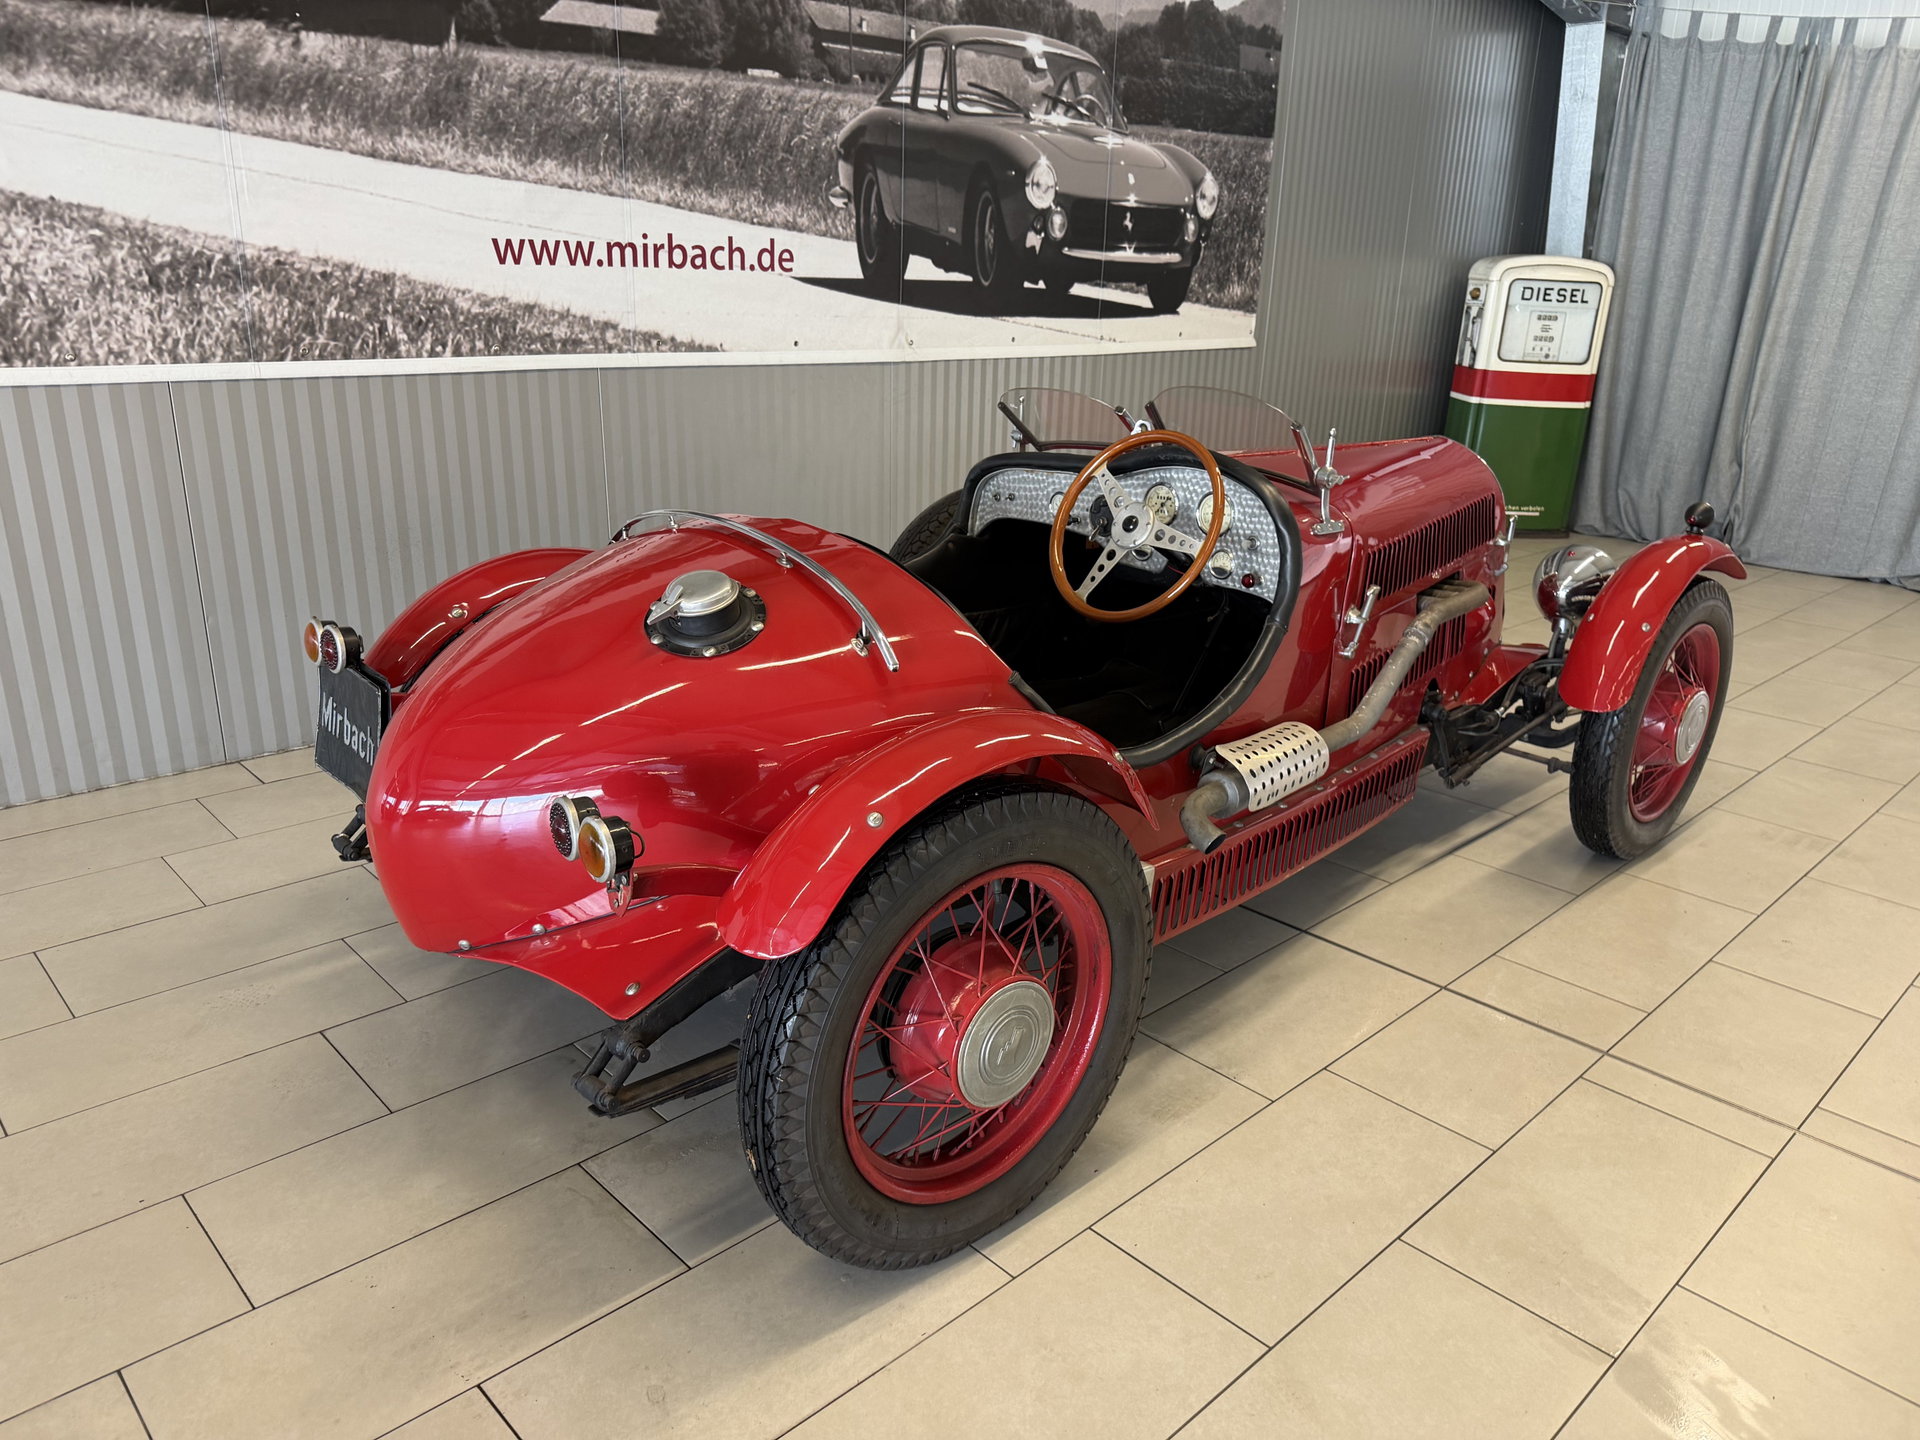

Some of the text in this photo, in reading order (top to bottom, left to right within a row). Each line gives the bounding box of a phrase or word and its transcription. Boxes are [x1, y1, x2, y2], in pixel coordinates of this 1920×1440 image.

[491, 233, 795, 273] www.mirbach.de
[1521, 287, 1589, 304] DIESEL
[321, 691, 374, 766] Mirbach
